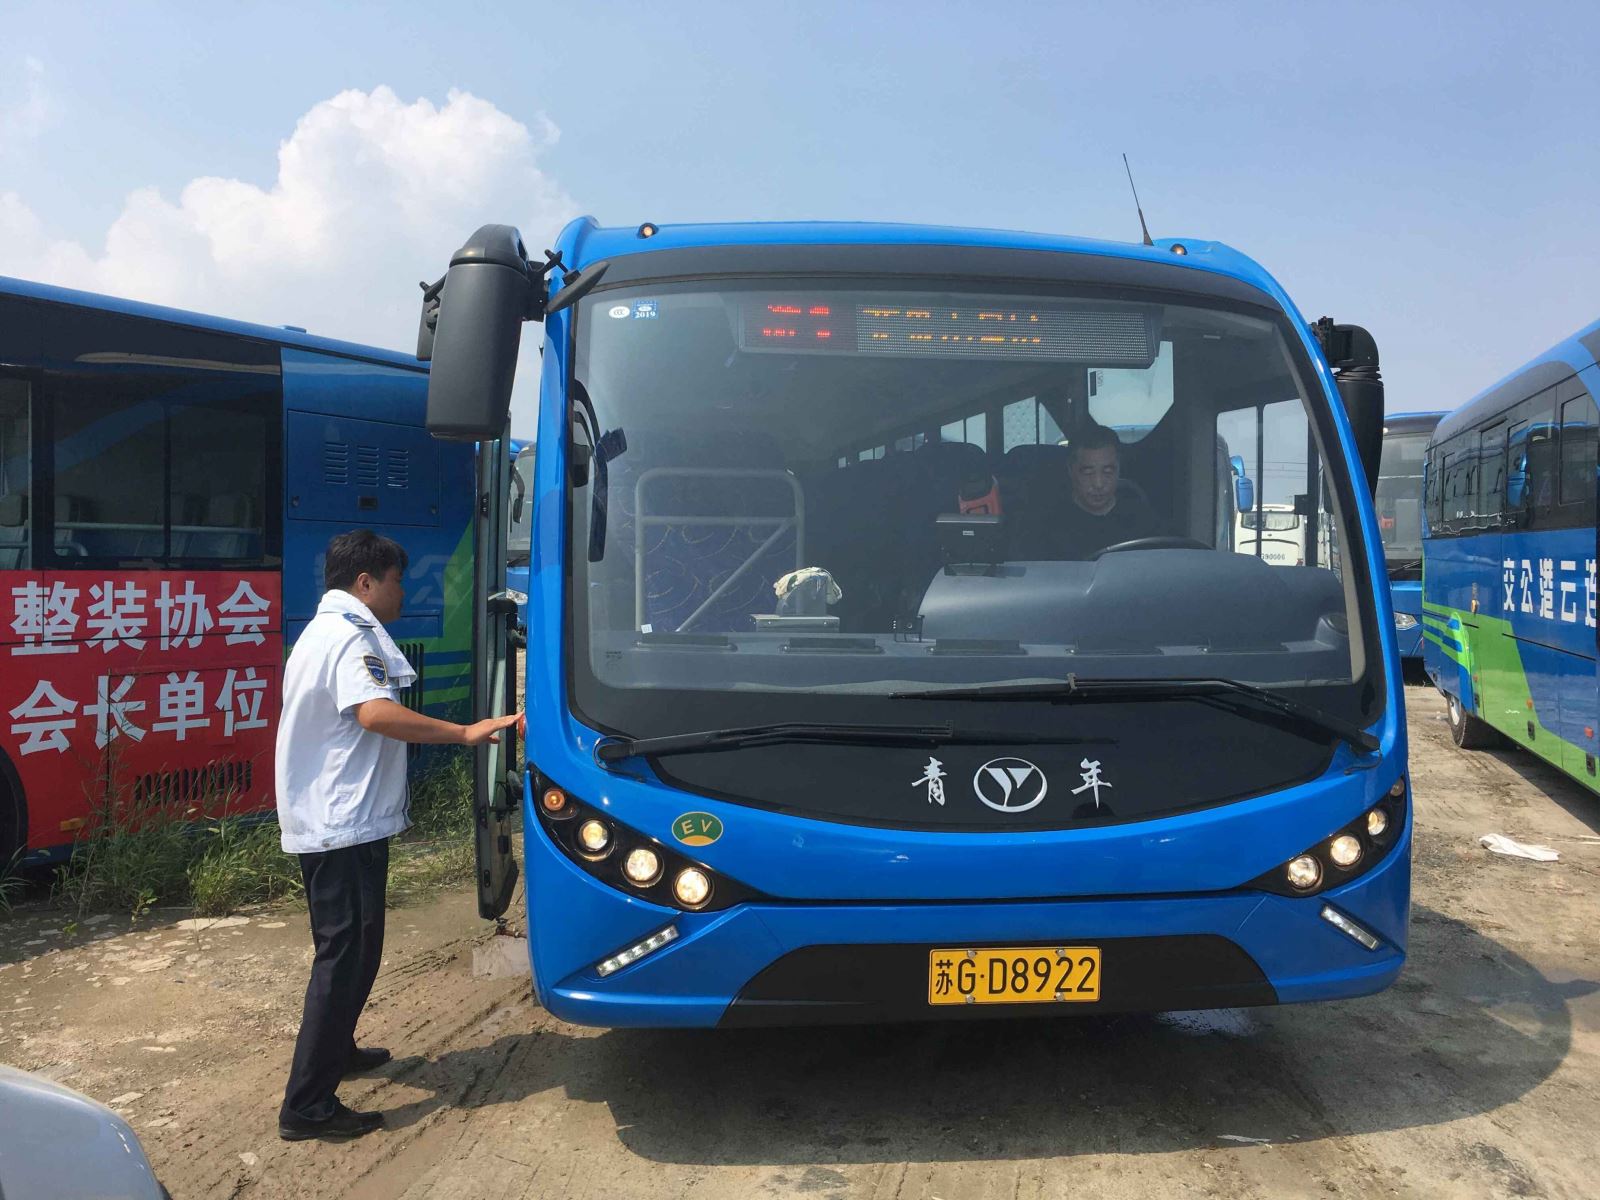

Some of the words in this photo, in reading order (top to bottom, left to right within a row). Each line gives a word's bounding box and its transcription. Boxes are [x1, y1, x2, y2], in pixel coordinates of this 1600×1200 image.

[634, 311, 656, 319] 2019
[10, 580, 271, 656] 整装协会
[8, 667, 269, 756] 会长单位
[681, 819, 713, 835] EV
